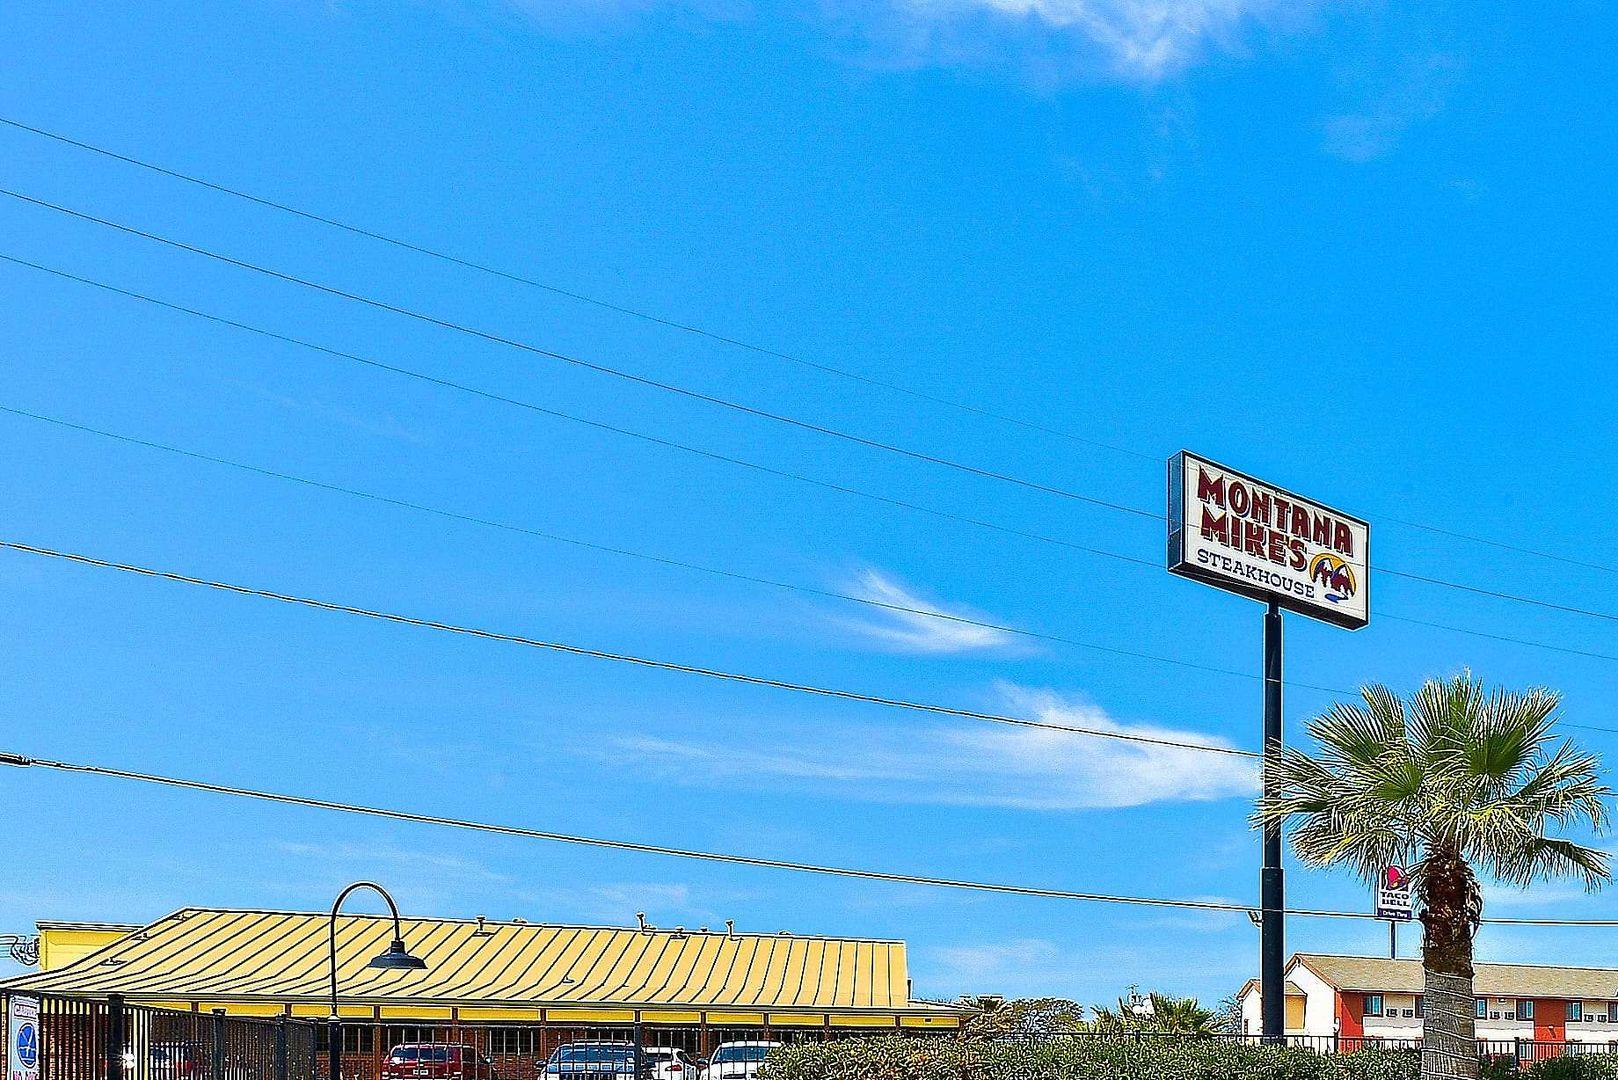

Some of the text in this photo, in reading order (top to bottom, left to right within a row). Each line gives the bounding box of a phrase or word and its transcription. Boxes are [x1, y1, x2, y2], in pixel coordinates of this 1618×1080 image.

[1197, 464, 1354, 557] MONTANA
[1200, 505, 1308, 571] MIKE'S
[1197, 549, 1315, 598] STEAKHOUSE
[1380, 891, 1409, 900] TACO
[1382, 898, 1410, 907] BELL
